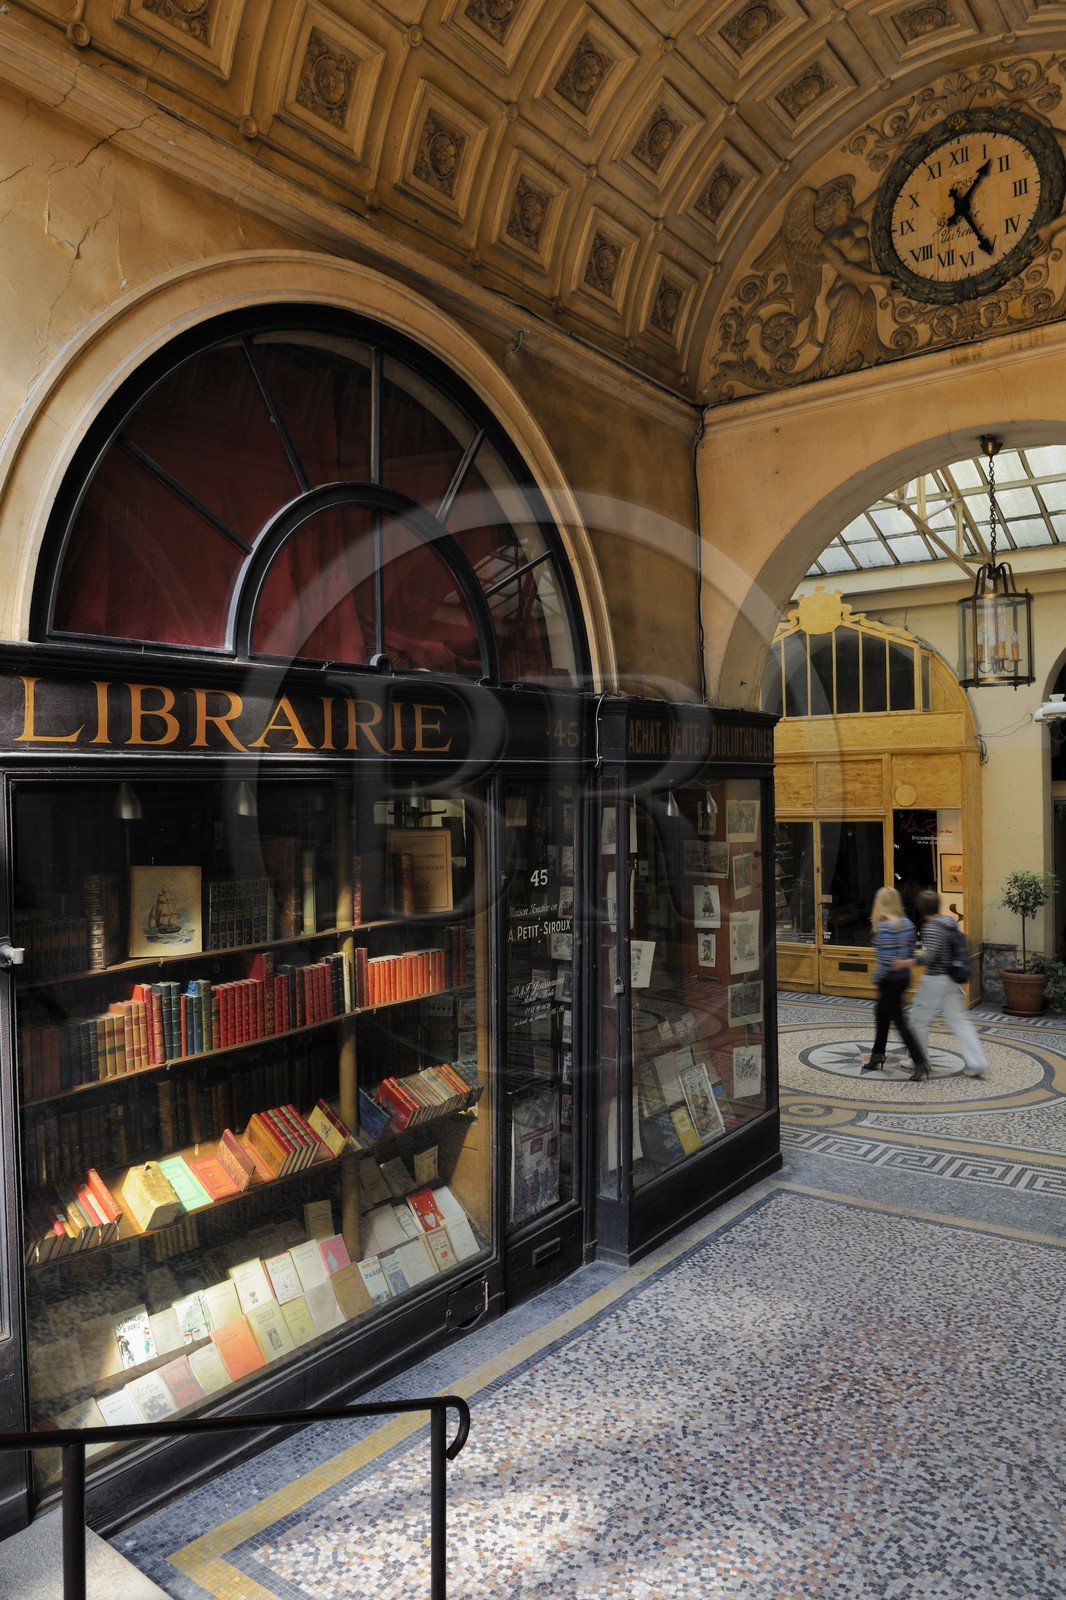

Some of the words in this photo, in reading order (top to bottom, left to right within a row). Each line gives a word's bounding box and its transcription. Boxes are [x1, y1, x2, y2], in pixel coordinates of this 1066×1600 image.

[948, 146, 970, 168] XII
[997, 154, 1011, 174] II
[926, 162, 943, 181] XI
[1012, 177, 1029, 198] III
[908, 192, 920, 210] X
[899, 218, 916, 236] IX
[1004, 215, 1022, 235] IV
[909, 244, 934, 262] VIII
[937, 249, 956, 269] VII
[959, 251, 976, 268] VI
[14, 676, 453, 755] LIBRAIRIE
[628, 719, 662, 754] ACHAT
[668, 722, 700, 755] VENTE
[530, 869, 548, 887] 45
[507, 929, 516, 943] A.
